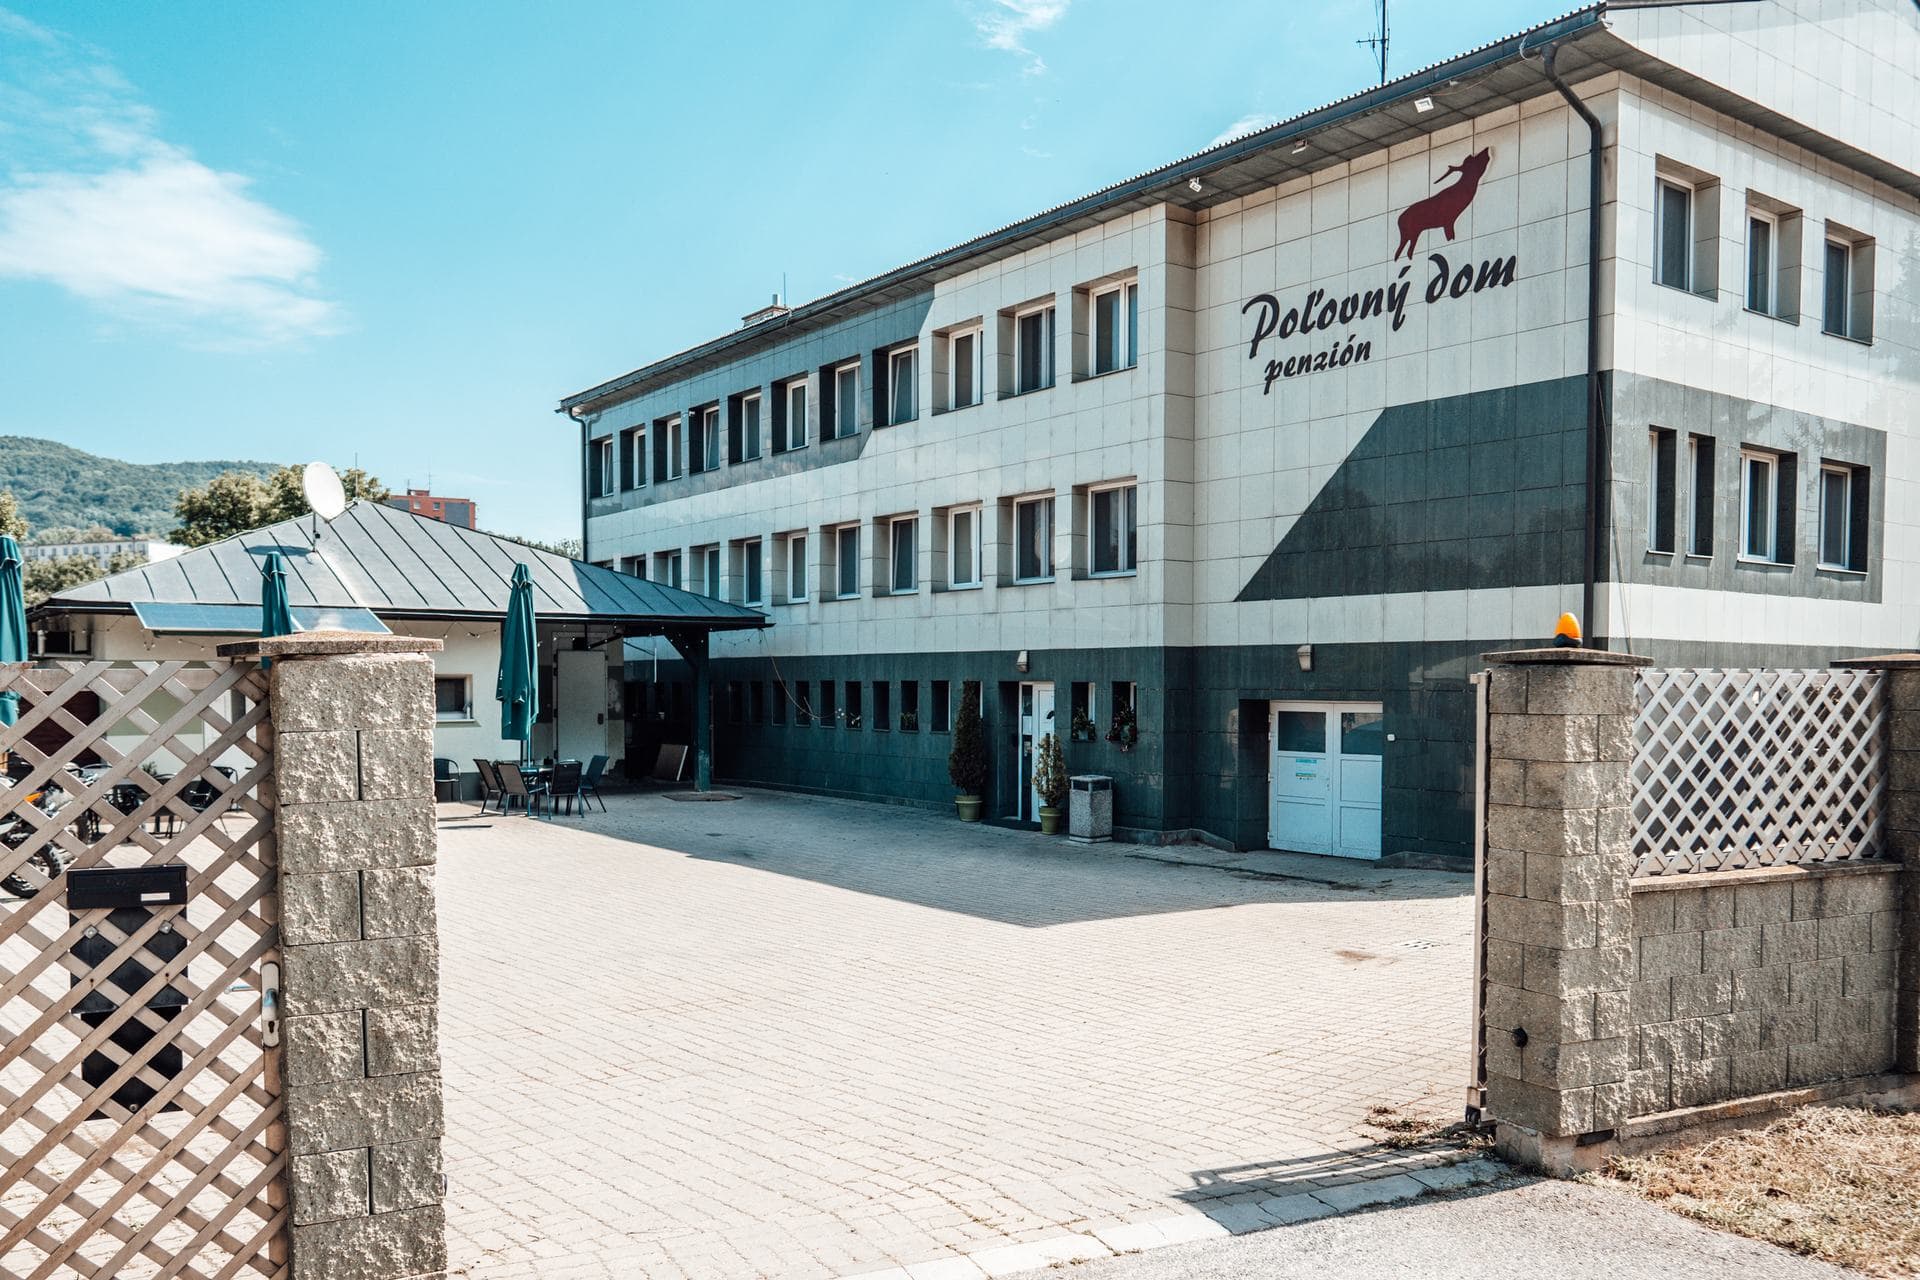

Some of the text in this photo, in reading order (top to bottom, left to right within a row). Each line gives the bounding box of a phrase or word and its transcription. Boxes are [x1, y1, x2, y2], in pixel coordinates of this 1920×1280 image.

[1242, 253, 1517, 359] Poľovný dom
[1264, 334, 1372, 395] penzión
